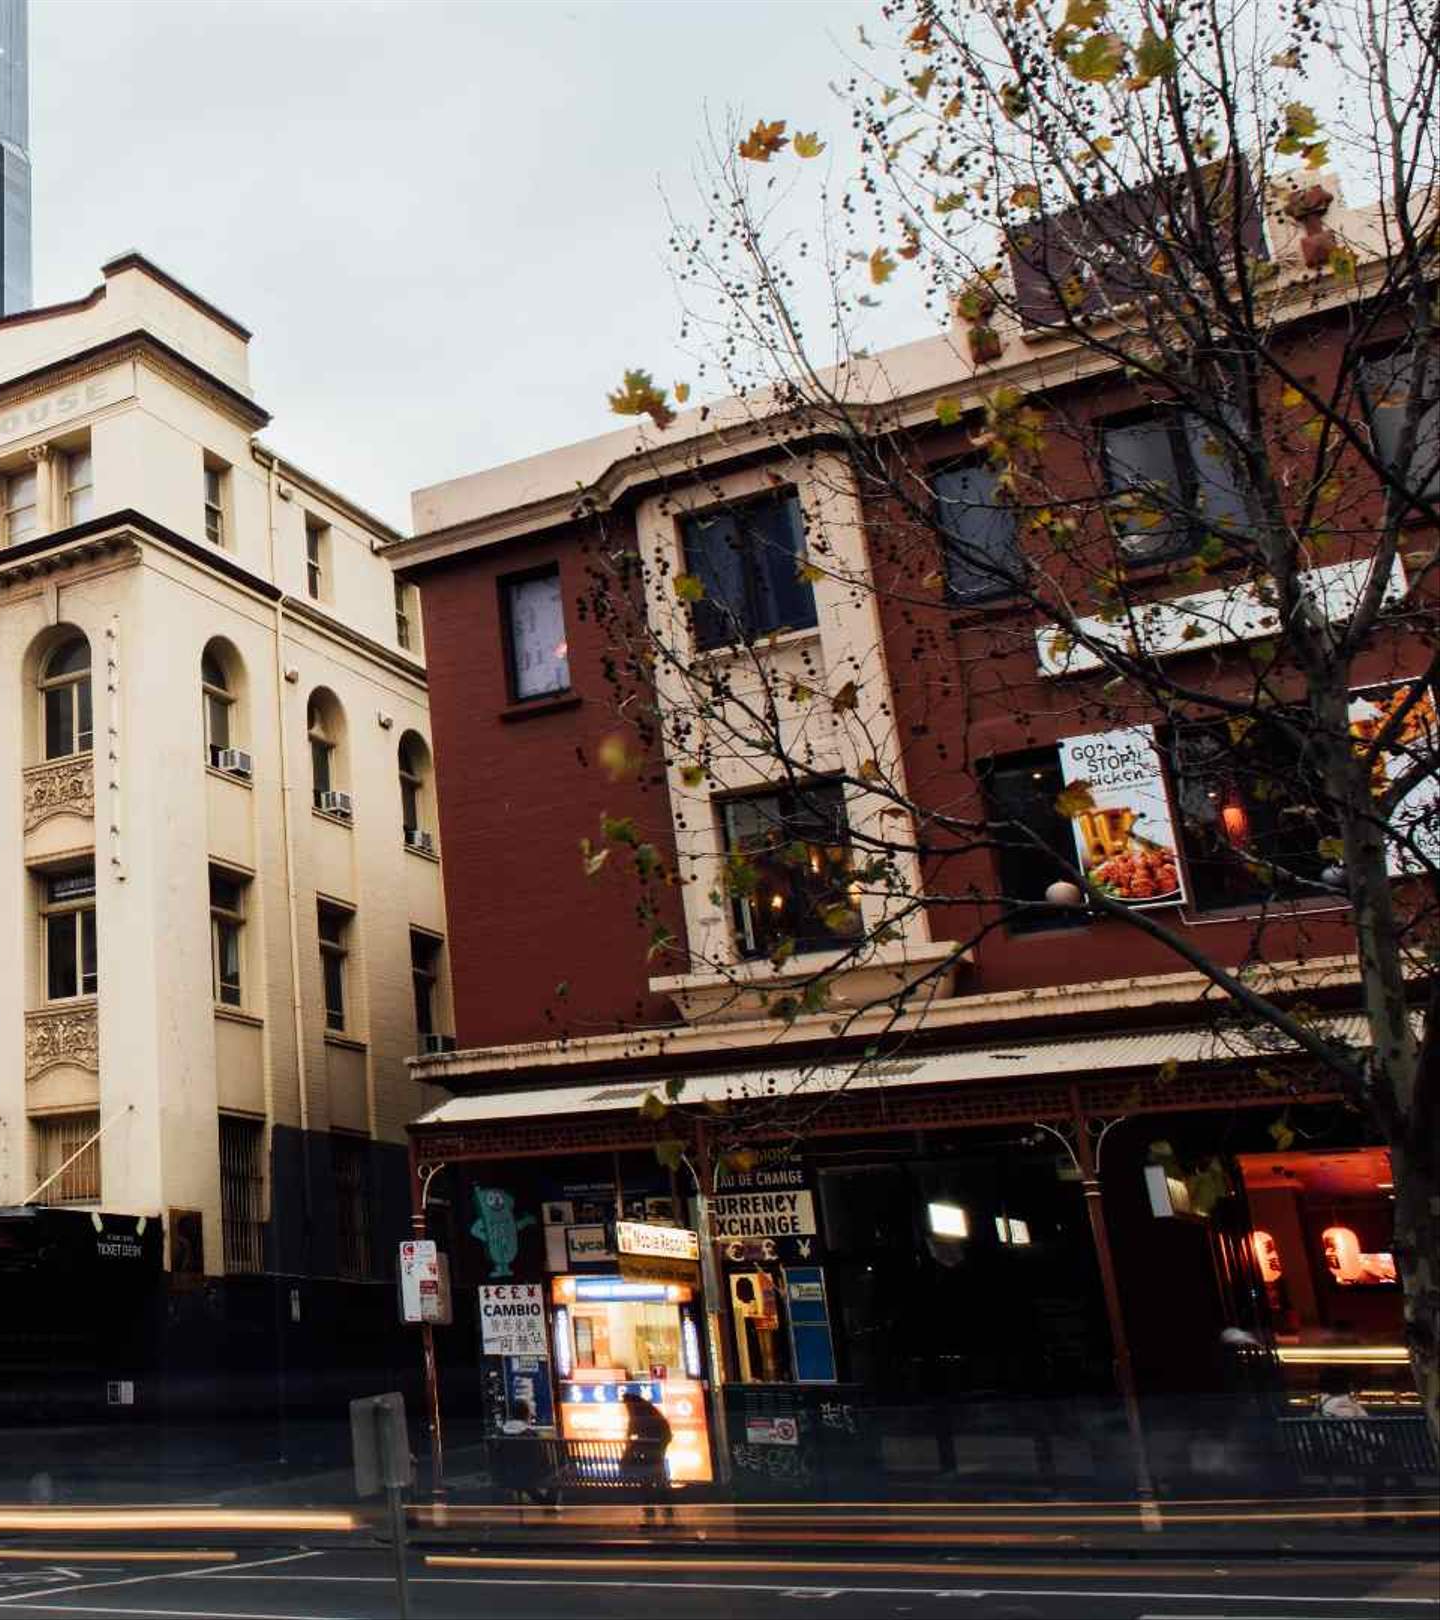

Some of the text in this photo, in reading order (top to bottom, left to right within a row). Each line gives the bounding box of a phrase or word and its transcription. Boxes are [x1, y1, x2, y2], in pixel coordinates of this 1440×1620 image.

[756, 1169, 805, 1186] CHANGE
[708, 1193, 798, 1216] URRENCY
[708, 1215, 800, 1237] XCHANGE
[483, 1302, 541, 1317] CAMBIO
